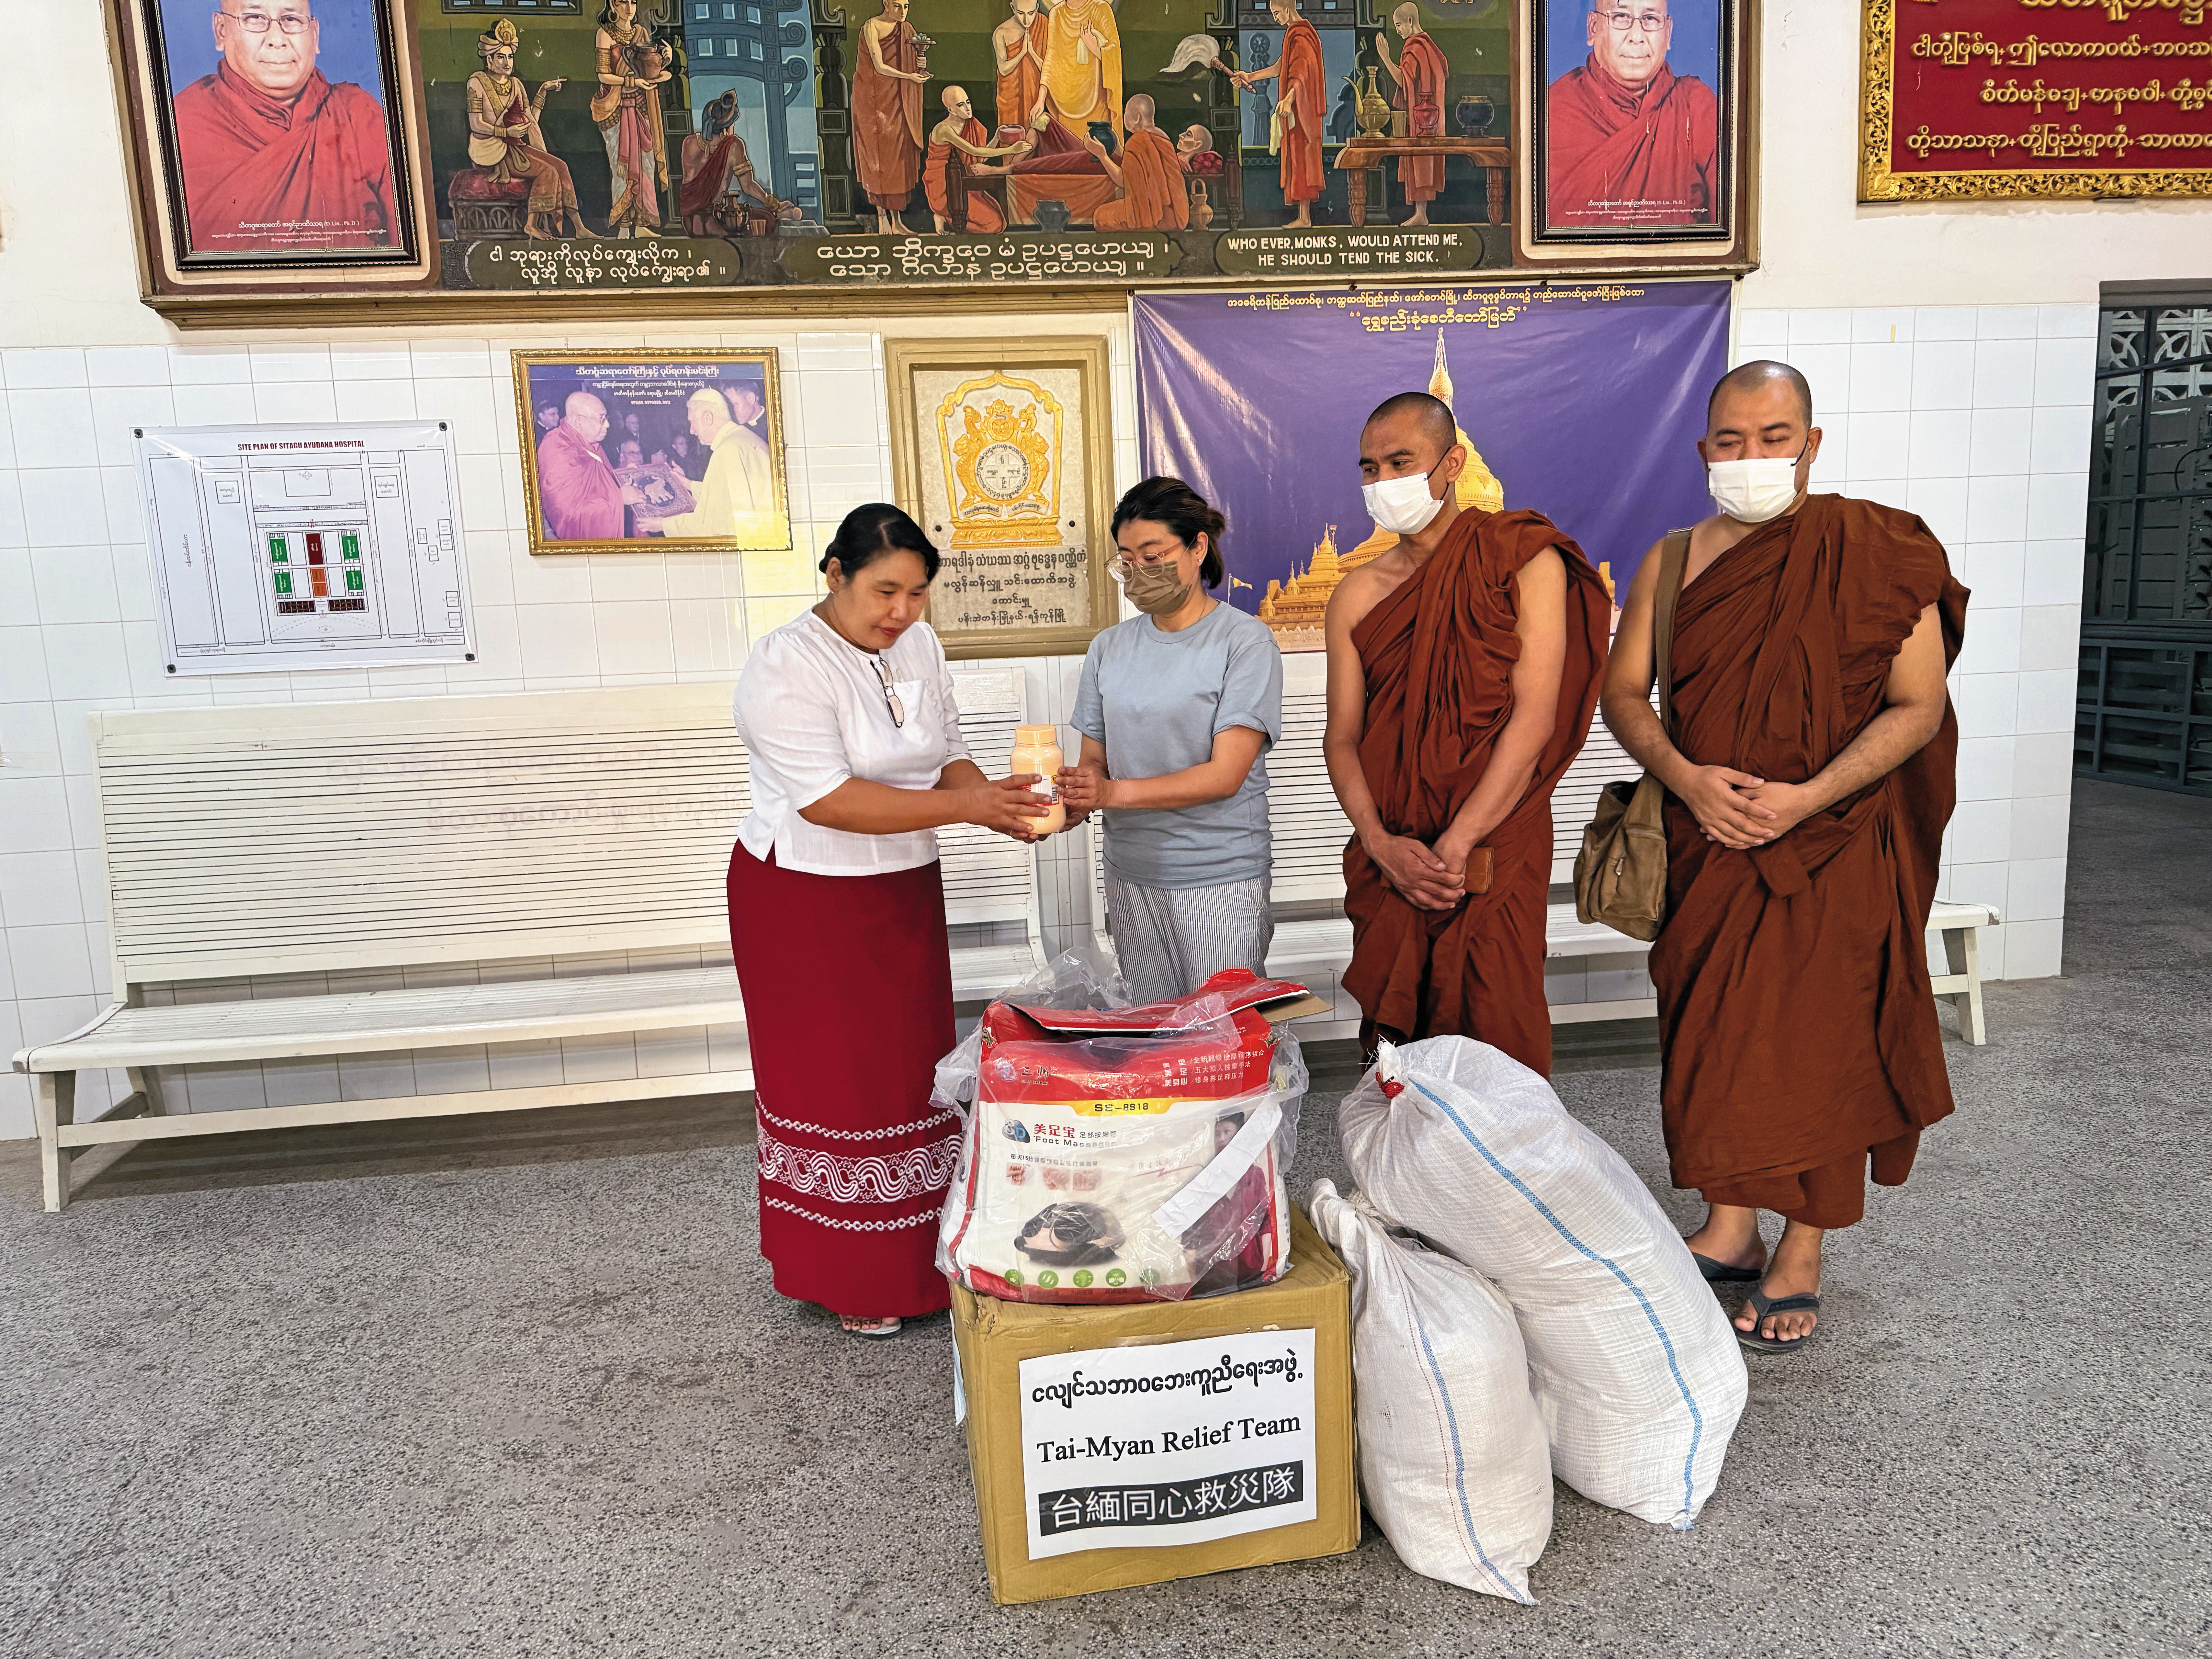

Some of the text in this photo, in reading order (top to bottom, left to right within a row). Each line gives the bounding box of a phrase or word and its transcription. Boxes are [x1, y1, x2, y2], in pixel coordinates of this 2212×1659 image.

[1228, 234, 1462, 250] WHO EVER, MONKS, WOULD ATTEND ME,
[1258, 251, 1439, 266] HE SHOULD TEND THE SICK.
[1034, 1123, 1075, 1138] 美足宝
[1035, 1136, 1059, 1144] Foot
[1032, 1348, 1304, 1408] ငလျင်သဘာဝဘေးကူညီရေးအဖွဲ့
[1037, 1415, 1301, 1463] Tai-Myan Relief Team
[1051, 1467, 1295, 1529] 台緬同心救災隊
